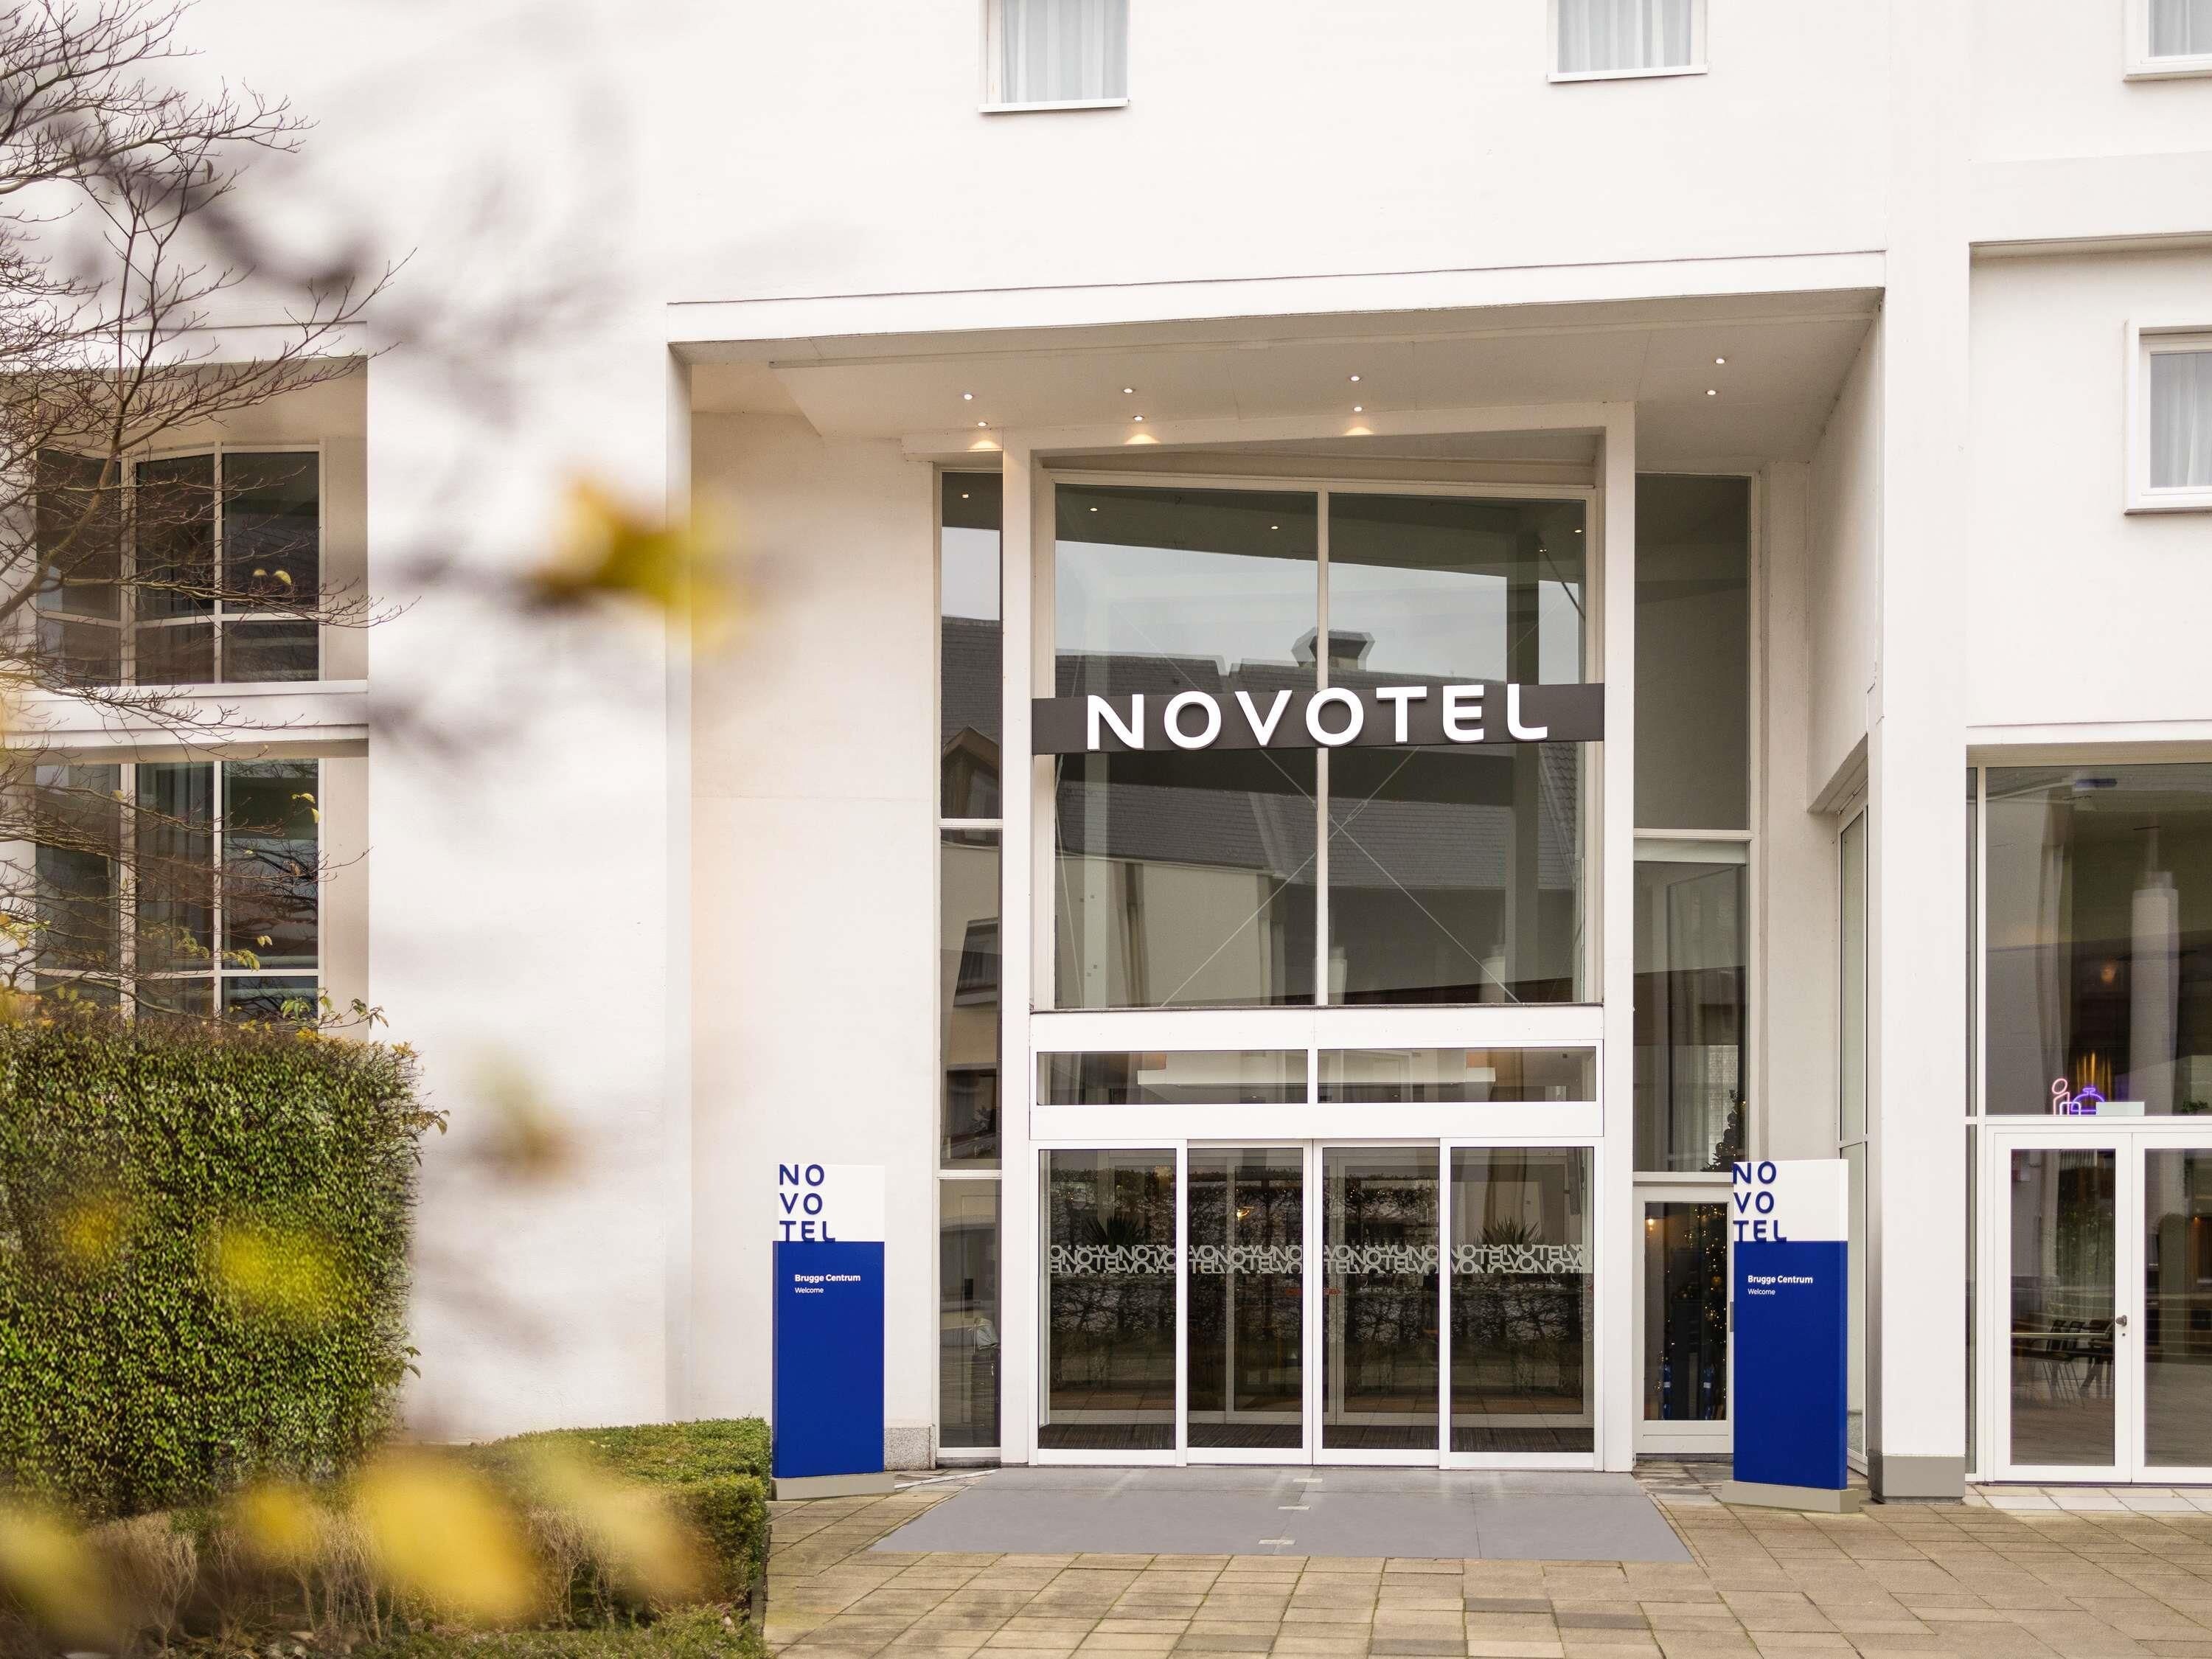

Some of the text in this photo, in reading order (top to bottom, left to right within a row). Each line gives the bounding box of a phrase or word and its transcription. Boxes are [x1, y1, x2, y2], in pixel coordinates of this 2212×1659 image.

[1088, 684, 1548, 751] NOVOTEL
[779, 1164, 824, 1186] NO
[1733, 1161, 1776, 1184] NO
[779, 1193, 822, 1215] VO
[1733, 1192, 1774, 1214] VO
[779, 1221, 835, 1242] TEL
[1733, 1220, 1787, 1242] TEL
[795, 1274, 824, 1283] Brugge
[1748, 1275, 1775, 1284] Brugge
